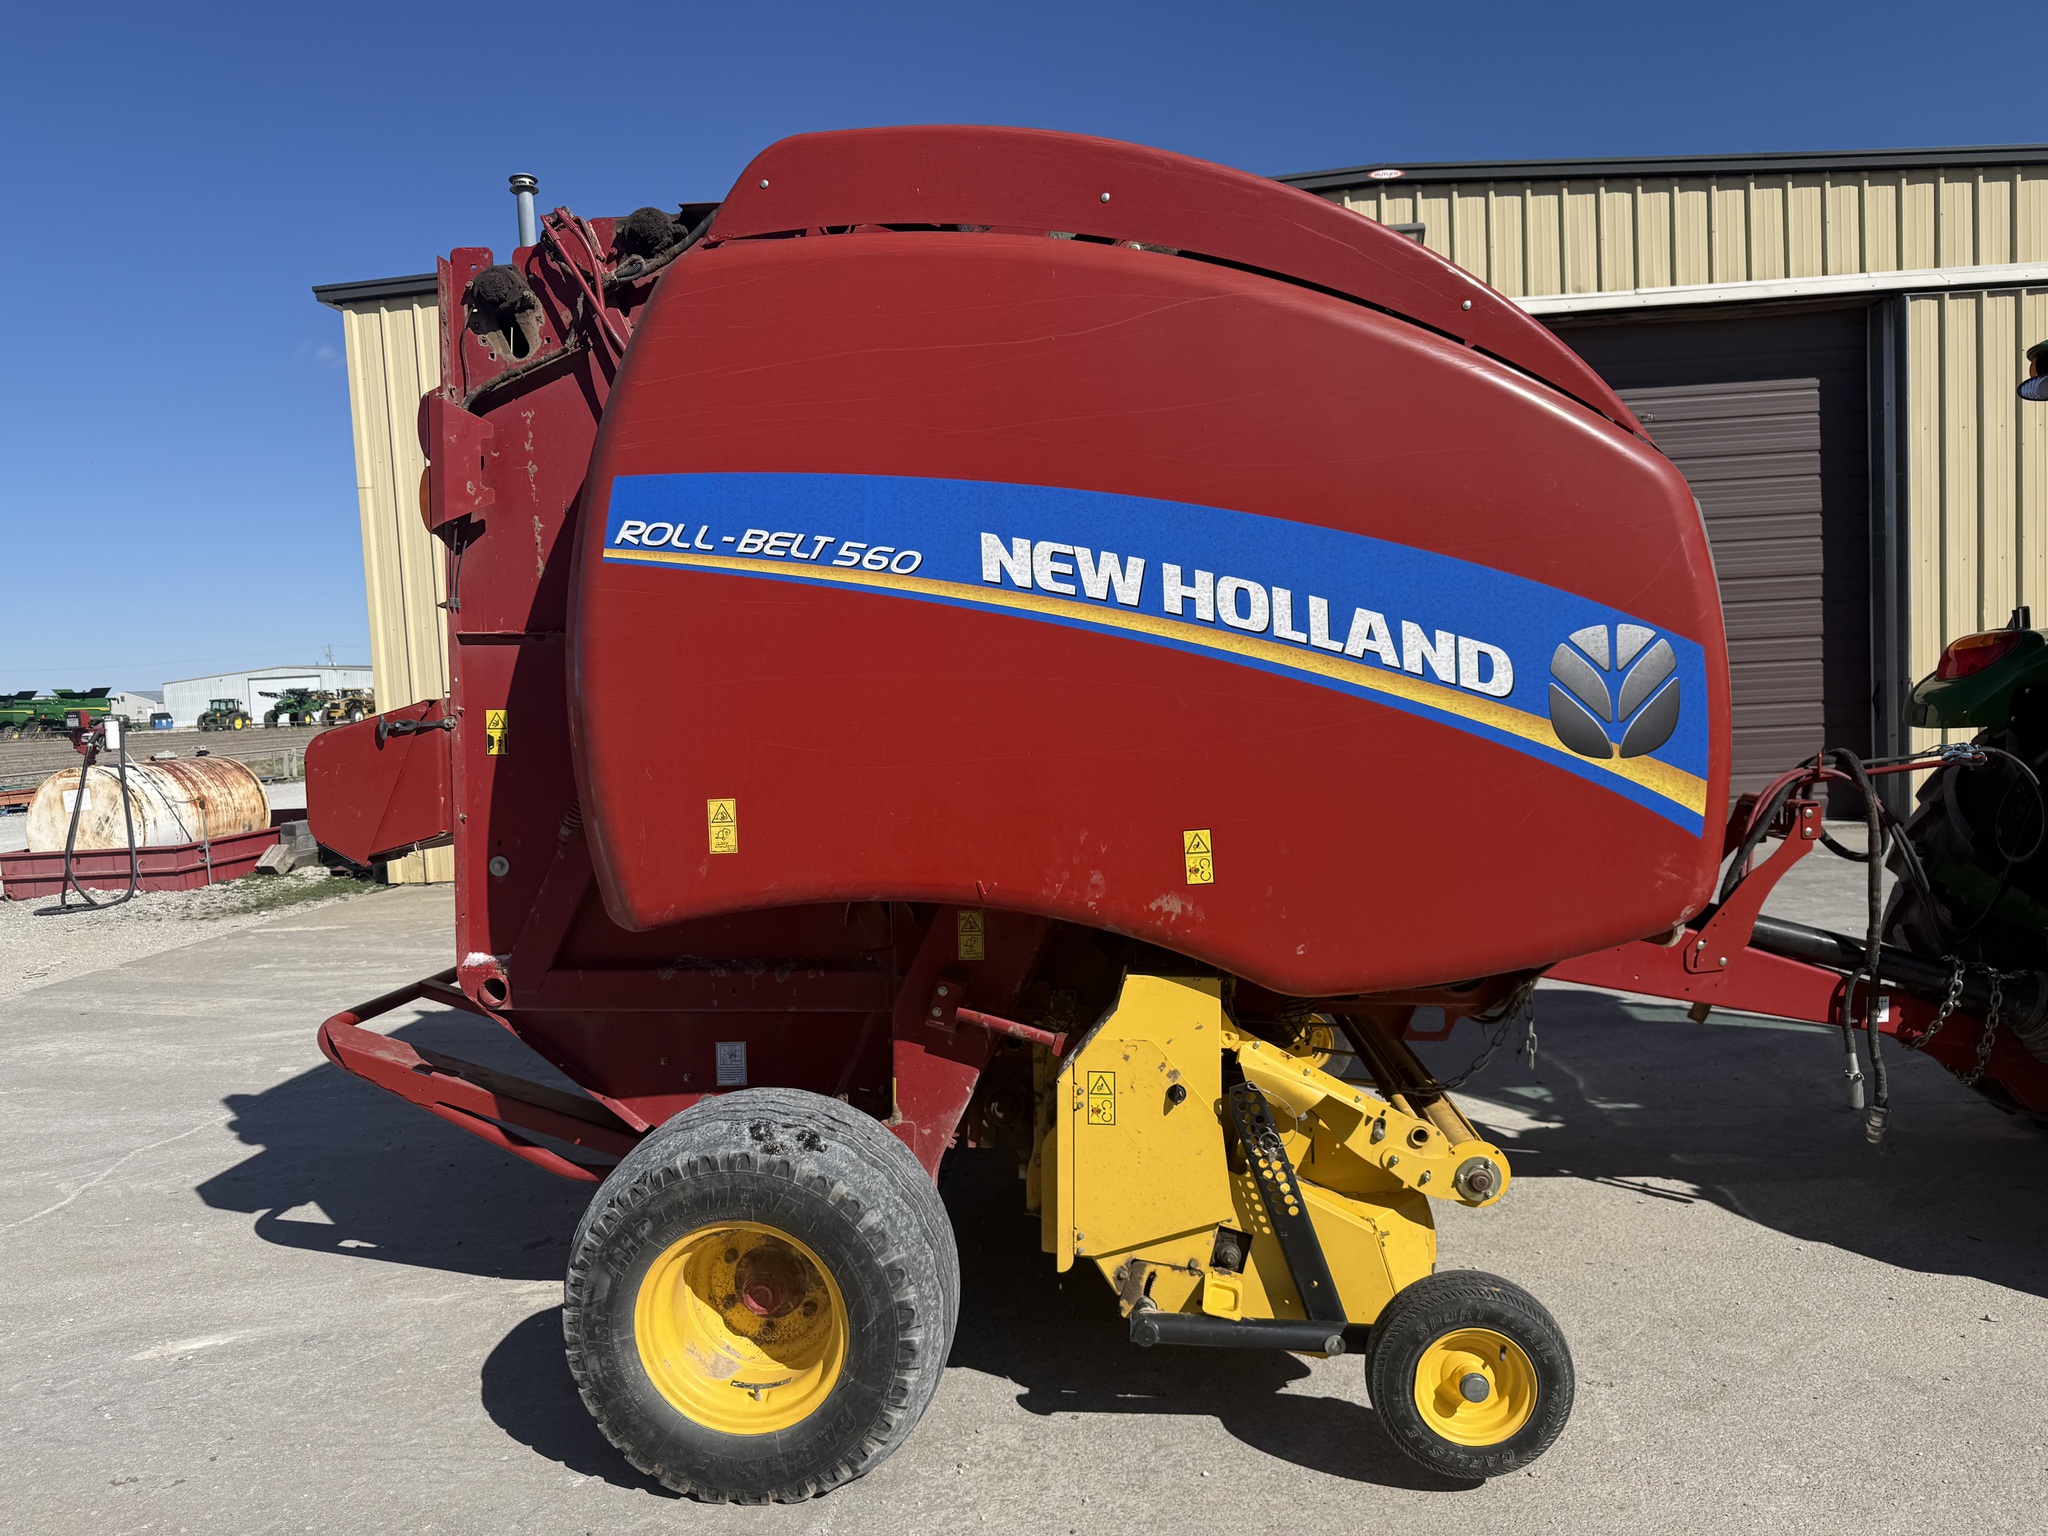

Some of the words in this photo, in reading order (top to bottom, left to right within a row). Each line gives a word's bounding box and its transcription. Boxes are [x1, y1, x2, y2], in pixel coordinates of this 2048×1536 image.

[614, 519, 835, 560] ROLL-BELT
[832, 541, 923, 575] 560
[980, 532, 1146, 607] NEW
[1162, 562, 1515, 698] HOLLAND
[606, 1185, 805, 1281] IMPLEMENT
[1415, 1307, 1487, 1340] SPORT
[1499, 1312, 1553, 1364] TRAIL
[1405, 1424, 1516, 1468] CARLISLE
